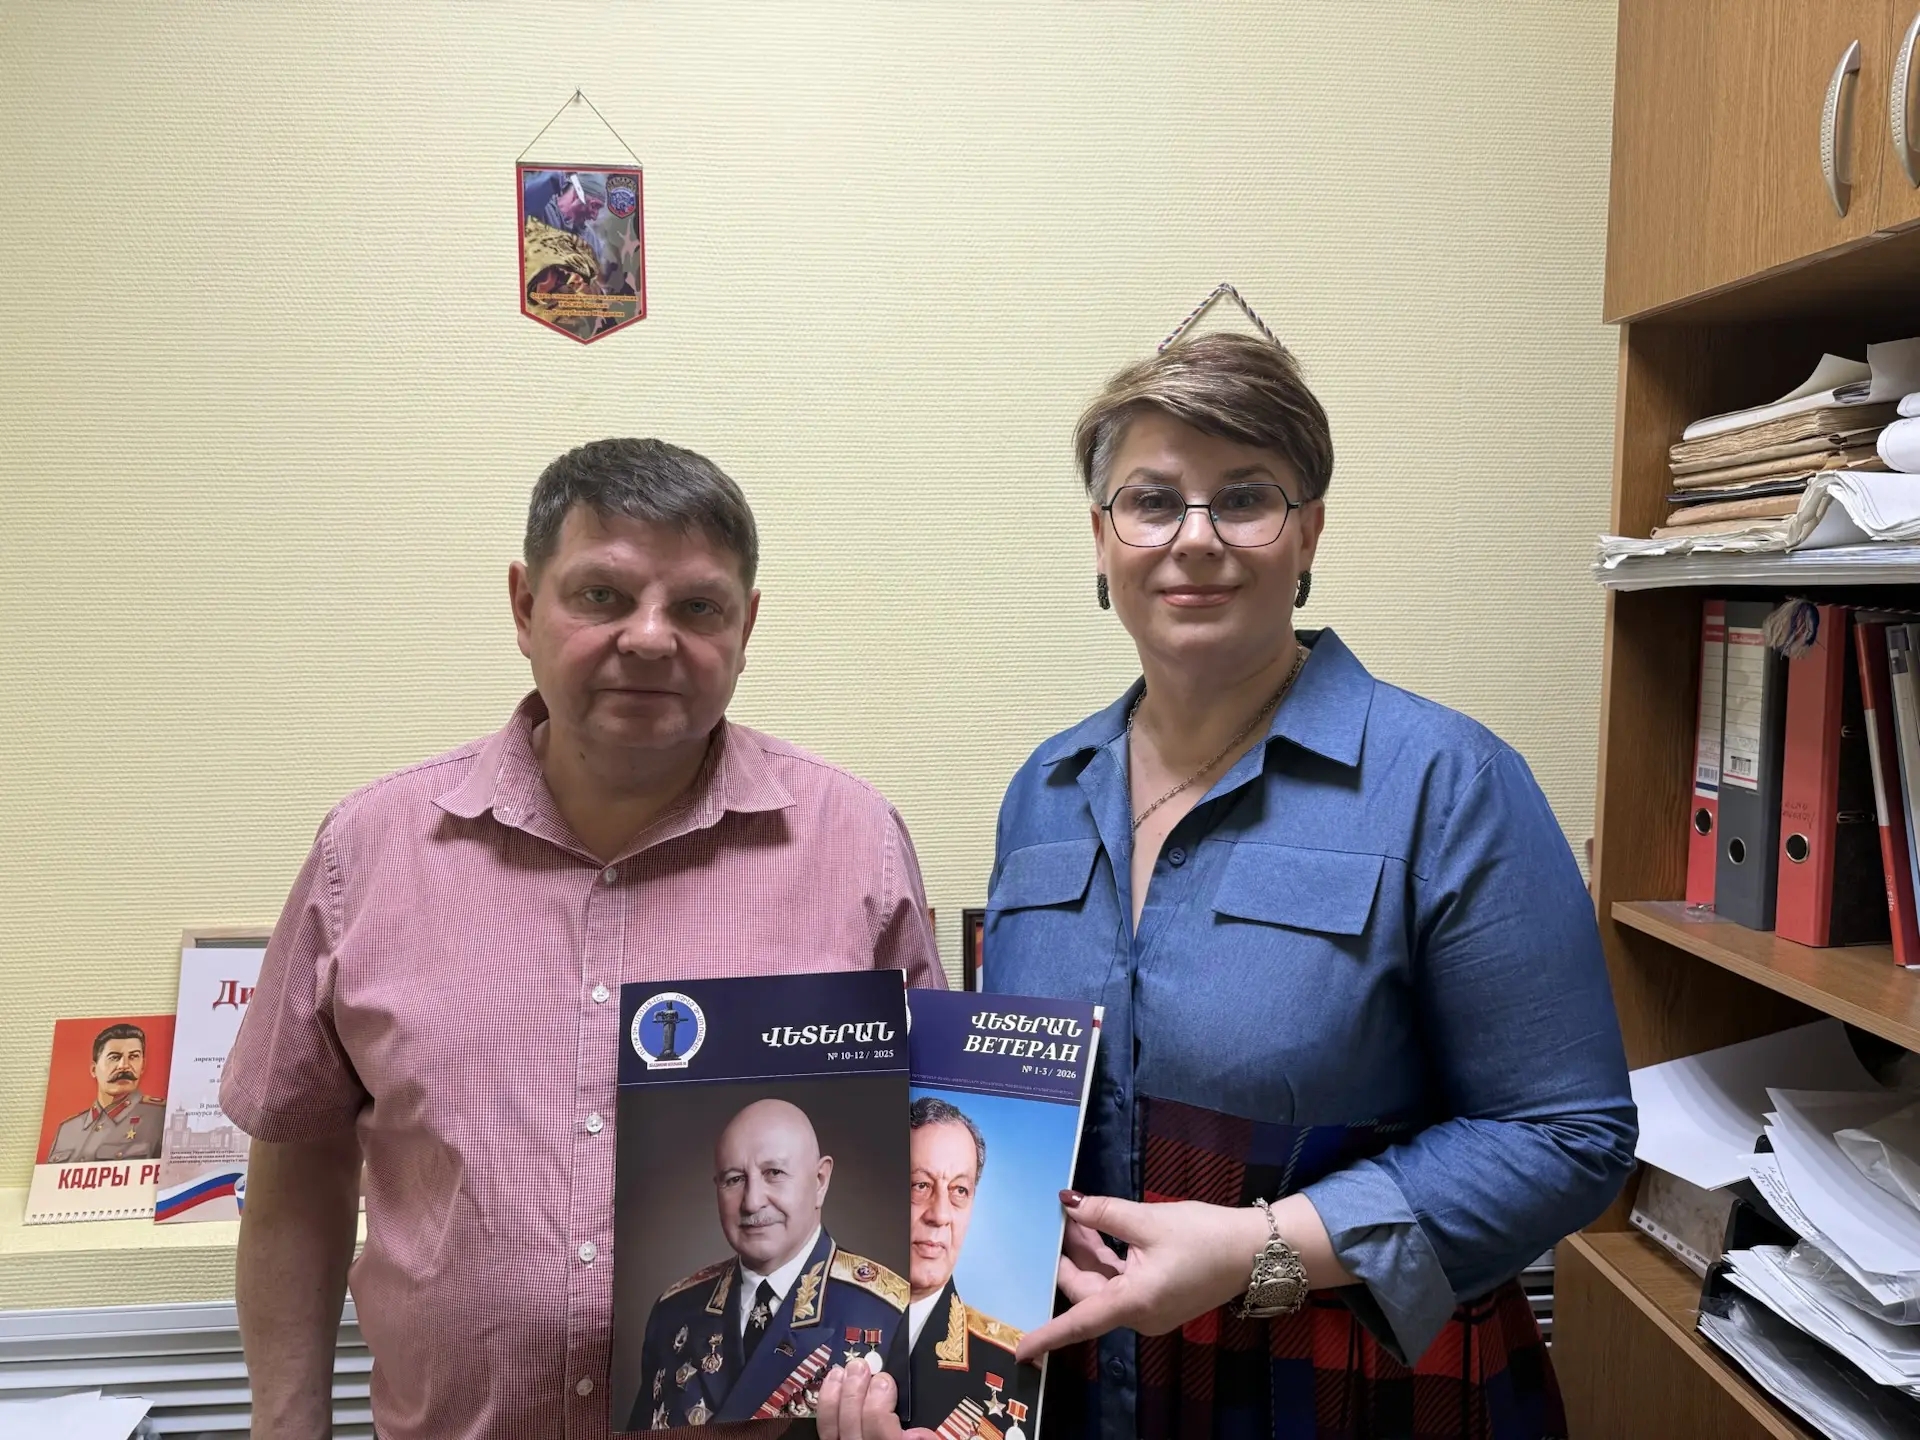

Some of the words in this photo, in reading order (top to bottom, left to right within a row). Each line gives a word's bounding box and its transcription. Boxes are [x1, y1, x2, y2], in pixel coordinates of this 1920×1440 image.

[761, 1021, 896, 1048] ՎԵՏԵՐԱՆ
[971, 1011, 1084, 1038] ՎԵՏԵՐԱՆ
[873, 1049, 895, 1059] 2025
[962, 1034, 1082, 1063] ВЕТЕРАН
[1056, 1069, 1077, 1080] 2026
[58, 1166, 130, 1190] КАДРЫ
